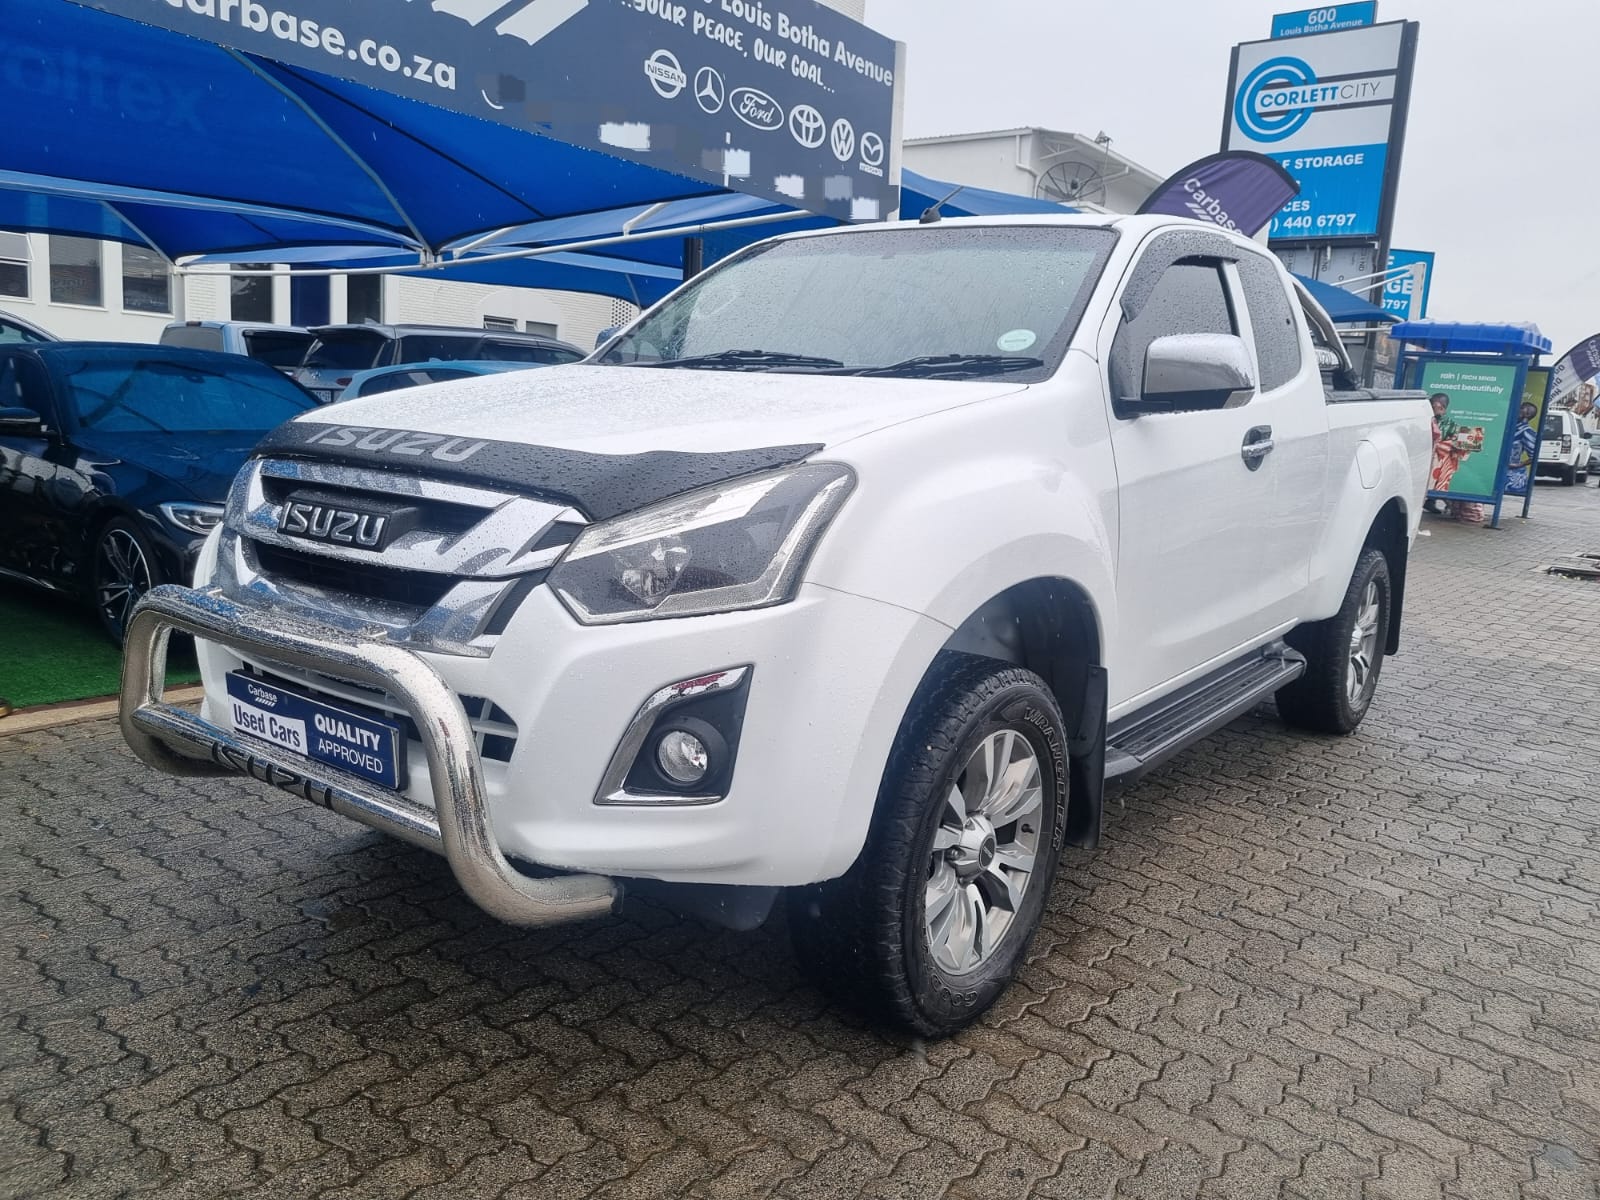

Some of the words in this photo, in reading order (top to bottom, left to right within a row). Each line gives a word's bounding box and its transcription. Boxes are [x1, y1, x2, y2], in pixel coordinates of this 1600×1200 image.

[1280, 28, 1302, 37] Louis
[1303, 23, 1329, 33] Botha
[1330, 18, 1363, 30] Avenue
[1308, 8, 1337, 24] 600
[164, 0, 457, 90] arbase.co.za
[693, 10, 747, 58] PEACE,
[754, 38, 787, 70] OUR
[721, 0, 772, 30] Louis
[778, 12, 829, 57] Botha
[834, 41, 893, 87] Avenue
[647, 63, 684, 84] NISSAN
[740, 92, 775, 125] Ford
[1294, 153, 1365, 170] STORAGE
[1283, 216, 1312, 229] 440
[1316, 213, 1356, 227] 6797
[1430, 382, 1461, 390] connect
[1461, 383, 1504, 394] beautifully
[305, 426, 490, 462] ISUZU
[279, 501, 386, 546] ISUZU
[247, 683, 278, 702] Carbase
[233, 703, 266, 734] Used
[269, 716, 300, 748] Cars
[314, 712, 381, 751] QUALITY
[318, 738, 383, 774] APPROVED
